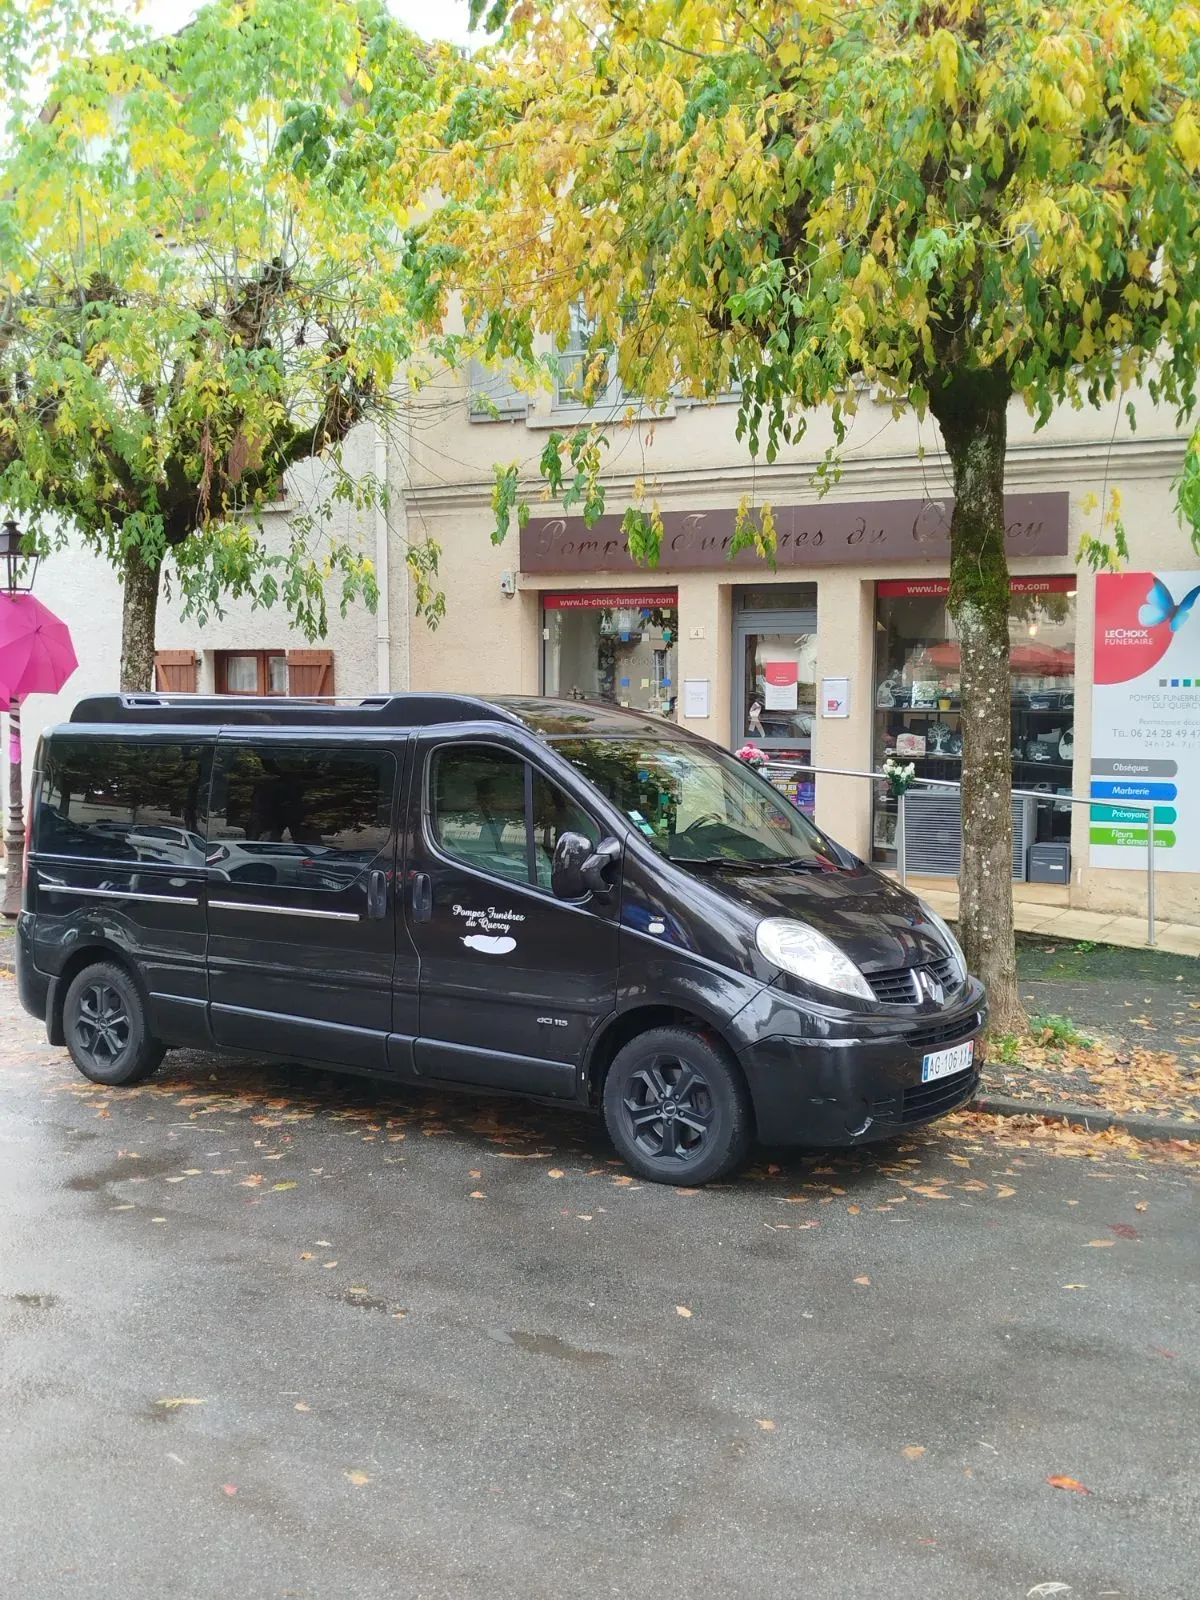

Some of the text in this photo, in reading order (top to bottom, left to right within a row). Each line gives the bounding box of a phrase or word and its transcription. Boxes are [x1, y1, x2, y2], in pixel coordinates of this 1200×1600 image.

[537, 519, 638, 560] Pomp
[847, 516, 888, 546] du
[559, 597, 674, 606] www.le-choix-funeraire.com
[1129, 694, 1160, 702] POMPES
[1130, 728, 1142, 738] 06
[1145, 728, 1157, 738] 24
[1160, 728, 1172, 738] 28
[1175, 728, 1187, 738] 49
[1112, 786, 1150, 795] Marbrerie
[1111, 809, 1149, 819] Prévoyanc
[1111, 829, 1133, 839] Fleurs
[452, 904, 526, 921] Pompes Funèbres
[465, 917, 511, 934] du Quercy
[555, 1019, 569, 1027] 115
